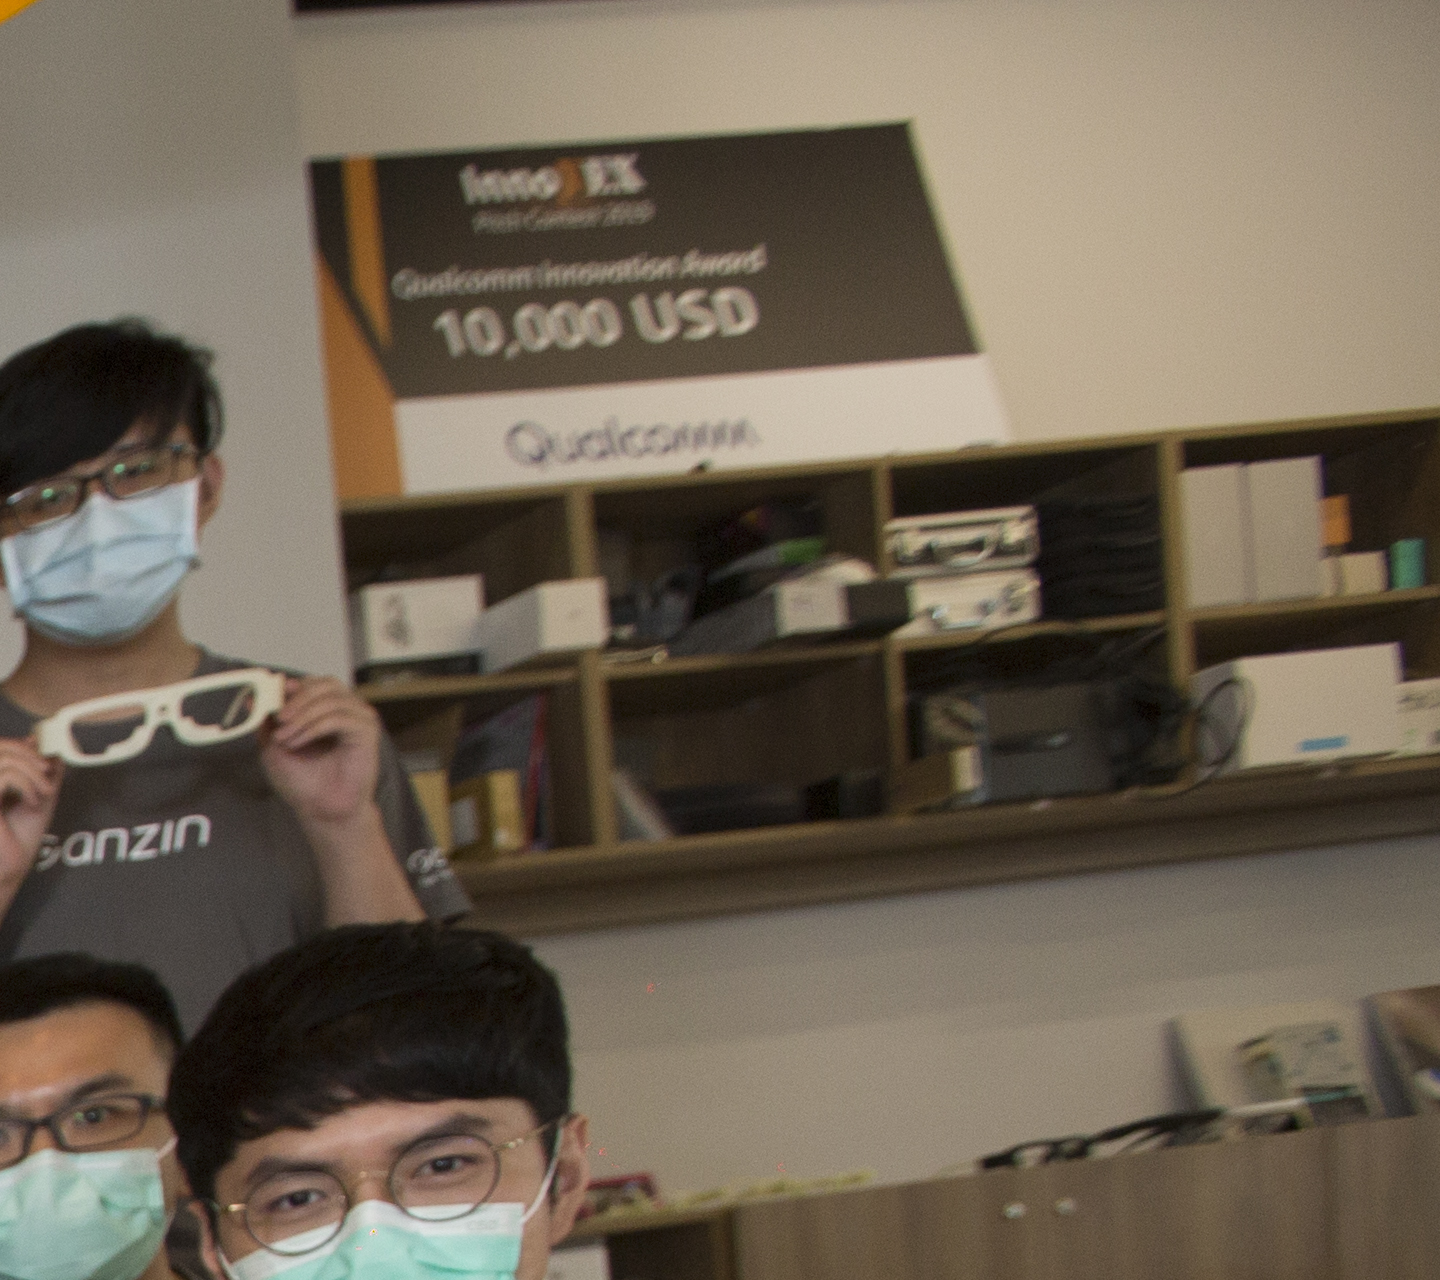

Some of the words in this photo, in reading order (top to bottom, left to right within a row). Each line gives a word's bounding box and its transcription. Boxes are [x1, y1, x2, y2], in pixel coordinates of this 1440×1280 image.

[391, 263, 533, 300] Qualcomm
[536, 251, 676, 289] Innovation
[678, 242, 768, 278] Award
[432, 297, 625, 360] 10,000
[628, 285, 761, 344] USD
